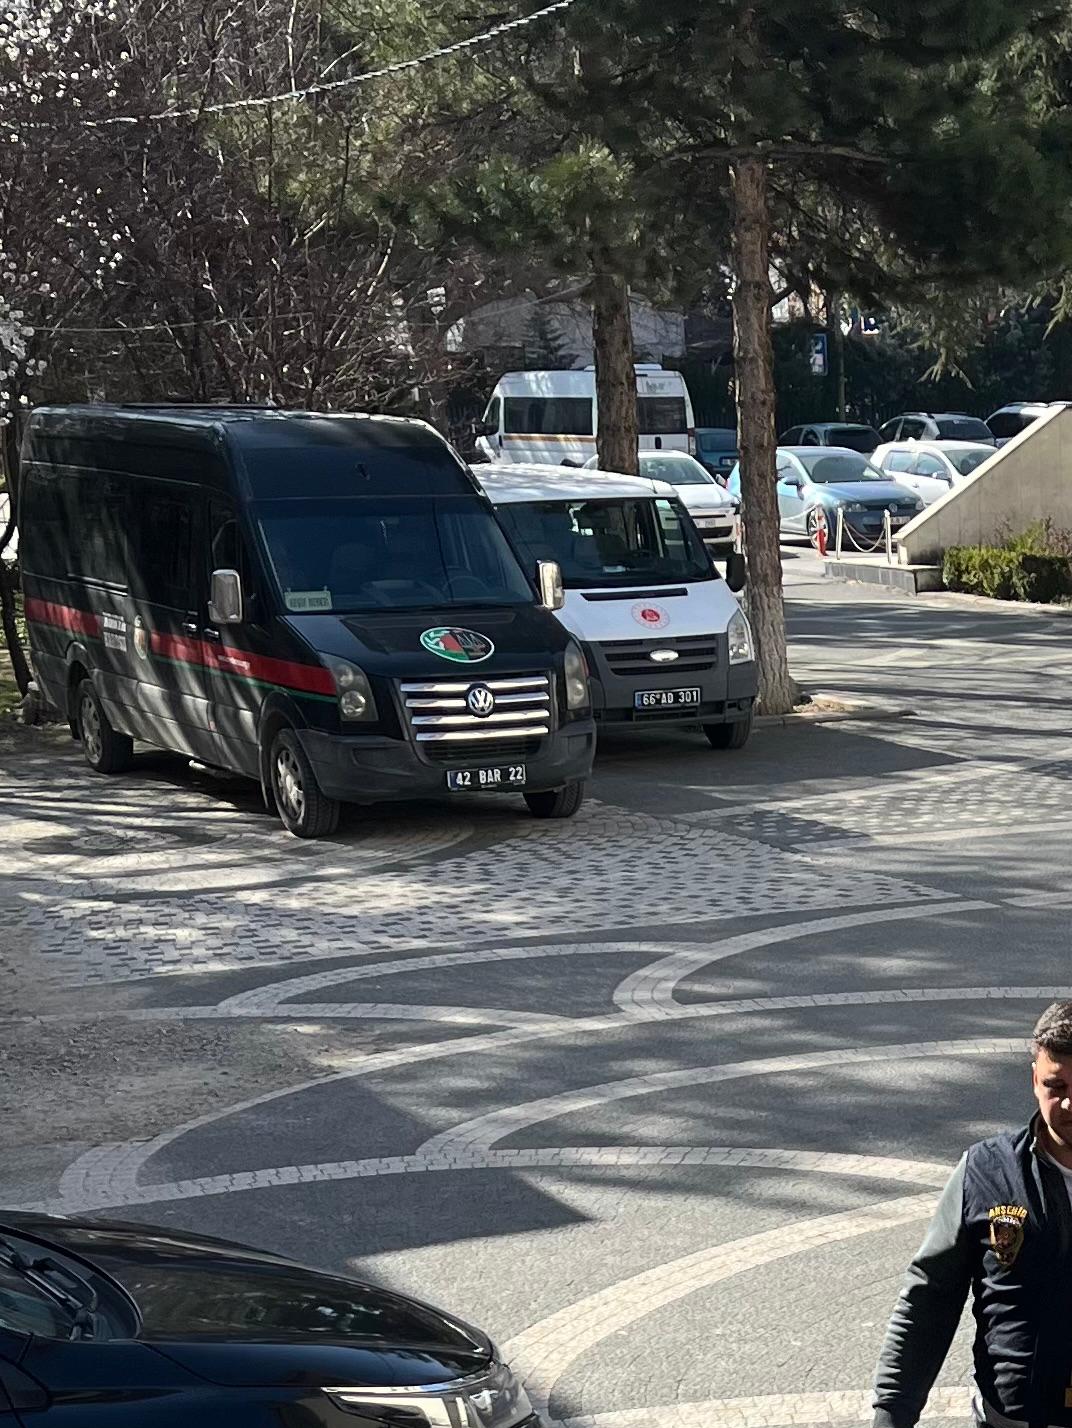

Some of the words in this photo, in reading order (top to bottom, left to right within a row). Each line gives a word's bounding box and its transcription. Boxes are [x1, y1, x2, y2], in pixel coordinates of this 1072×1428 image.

[643, 693, 656, 705] 66
[679, 691, 697, 703] 301
[456, 771, 472, 786] 42
[479, 769, 501, 784] BAR
[508, 766, 523, 781] 22
